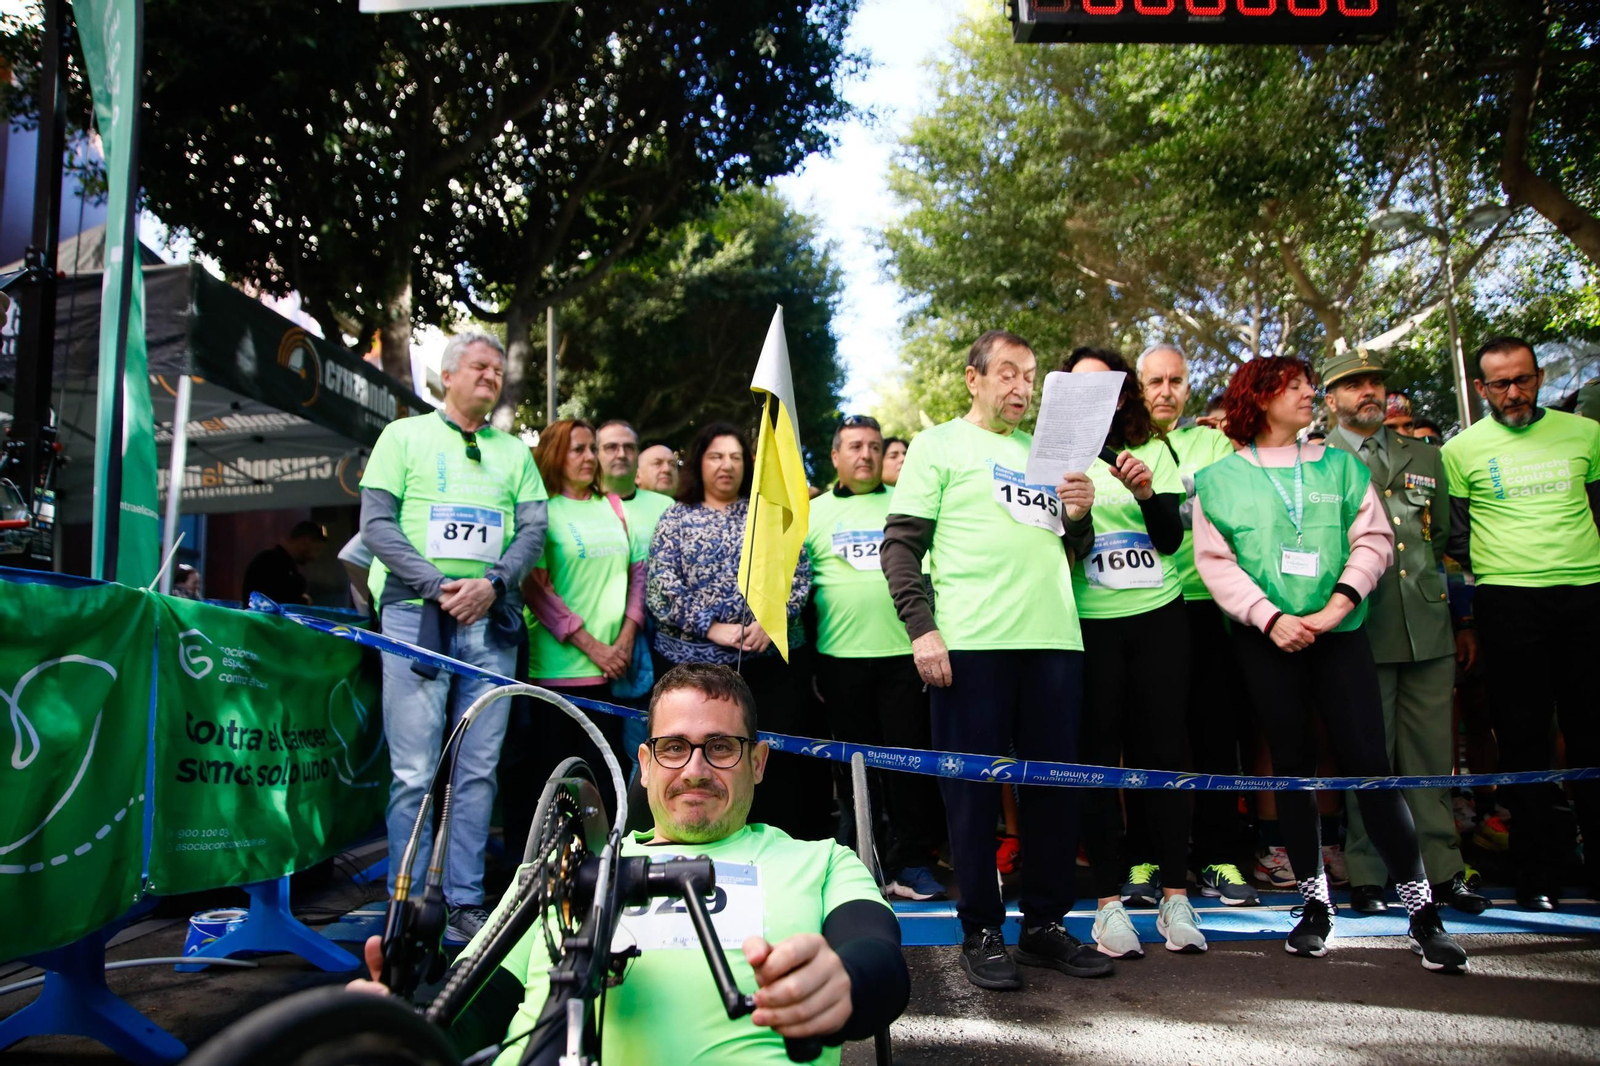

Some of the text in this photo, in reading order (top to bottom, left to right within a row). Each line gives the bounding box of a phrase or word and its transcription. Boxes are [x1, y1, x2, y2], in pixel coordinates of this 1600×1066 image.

[1503, 459, 1569, 476] En marcha
[1506, 466, 1571, 485] contra el
[1508, 480, 1573, 498] cáncer
[1001, 484, 1058, 517] 1545
[444, 522, 487, 543] 871
[839, 543, 879, 558] 152
[1091, 549, 1155, 573] 1600
[268, 722, 283, 751] el
[257, 757, 299, 787] solo
[303, 757, 329, 783] uno
[177, 829, 199, 838] 900
[201, 829, 217, 837] 100
